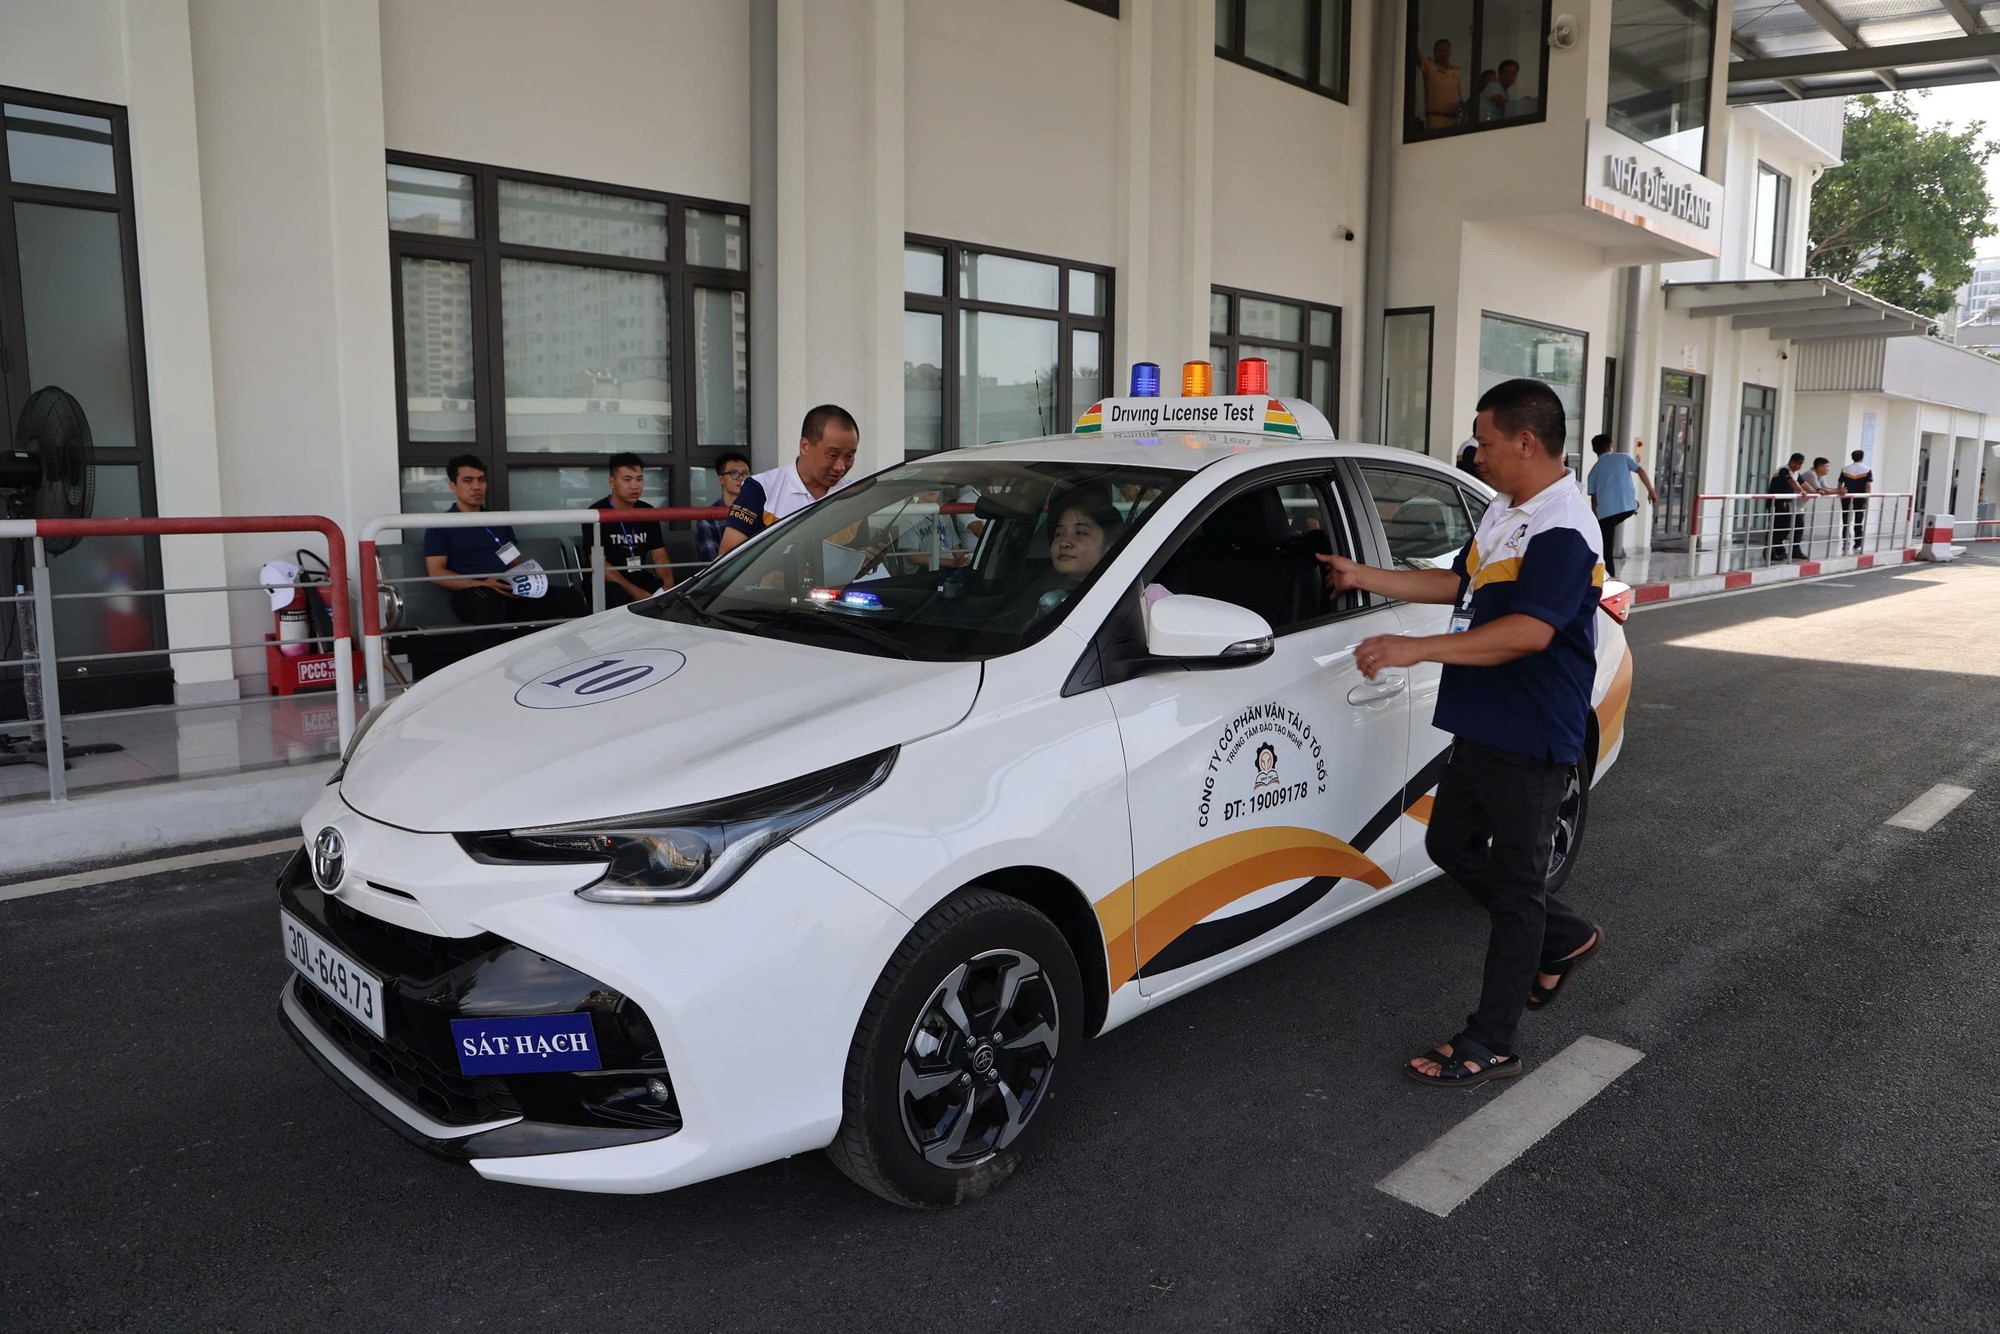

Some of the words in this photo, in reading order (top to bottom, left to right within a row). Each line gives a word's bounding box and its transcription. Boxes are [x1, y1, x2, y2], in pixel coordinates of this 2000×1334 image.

[1604, 156, 1641, 200] NHÀ
[1676, 183, 1711, 230] HÀNH
[1111, 405, 1159, 426] Driving
[1162, 403, 1219, 422] License
[1223, 402, 1255, 422] Test
[300, 661, 329, 681] PCCC
[541, 658, 655, 696] 10
[1232, 704, 1263, 734] PHẦN
[1264, 701, 1286, 721] VẬN
[1287, 710, 1304, 732] TẢI
[1218, 724, 1234, 752] CỔ
[1225, 736, 1246, 765] TRUNG
[1244, 726, 1260, 741] TÂM
[1259, 720, 1274, 733] ĐÀO
[1273, 723, 1287, 736] TẠO
[1302, 724, 1313, 740] Ô
[1308, 736, 1323, 759] TÔ
[1208, 749, 1223, 773] TY
[1316, 758, 1328, 782] SỐ
[1198, 776, 1216, 828] CÔNG
[1223, 798, 1246, 821] ĐT:
[1249, 781, 1309, 814] 19009178
[1317, 783, 1327, 795] 2
[288, 924, 373, 1020] 30L-649.73
[462, 1031, 510, 1057] SÁT
[513, 1032, 591, 1059] HẠCH
